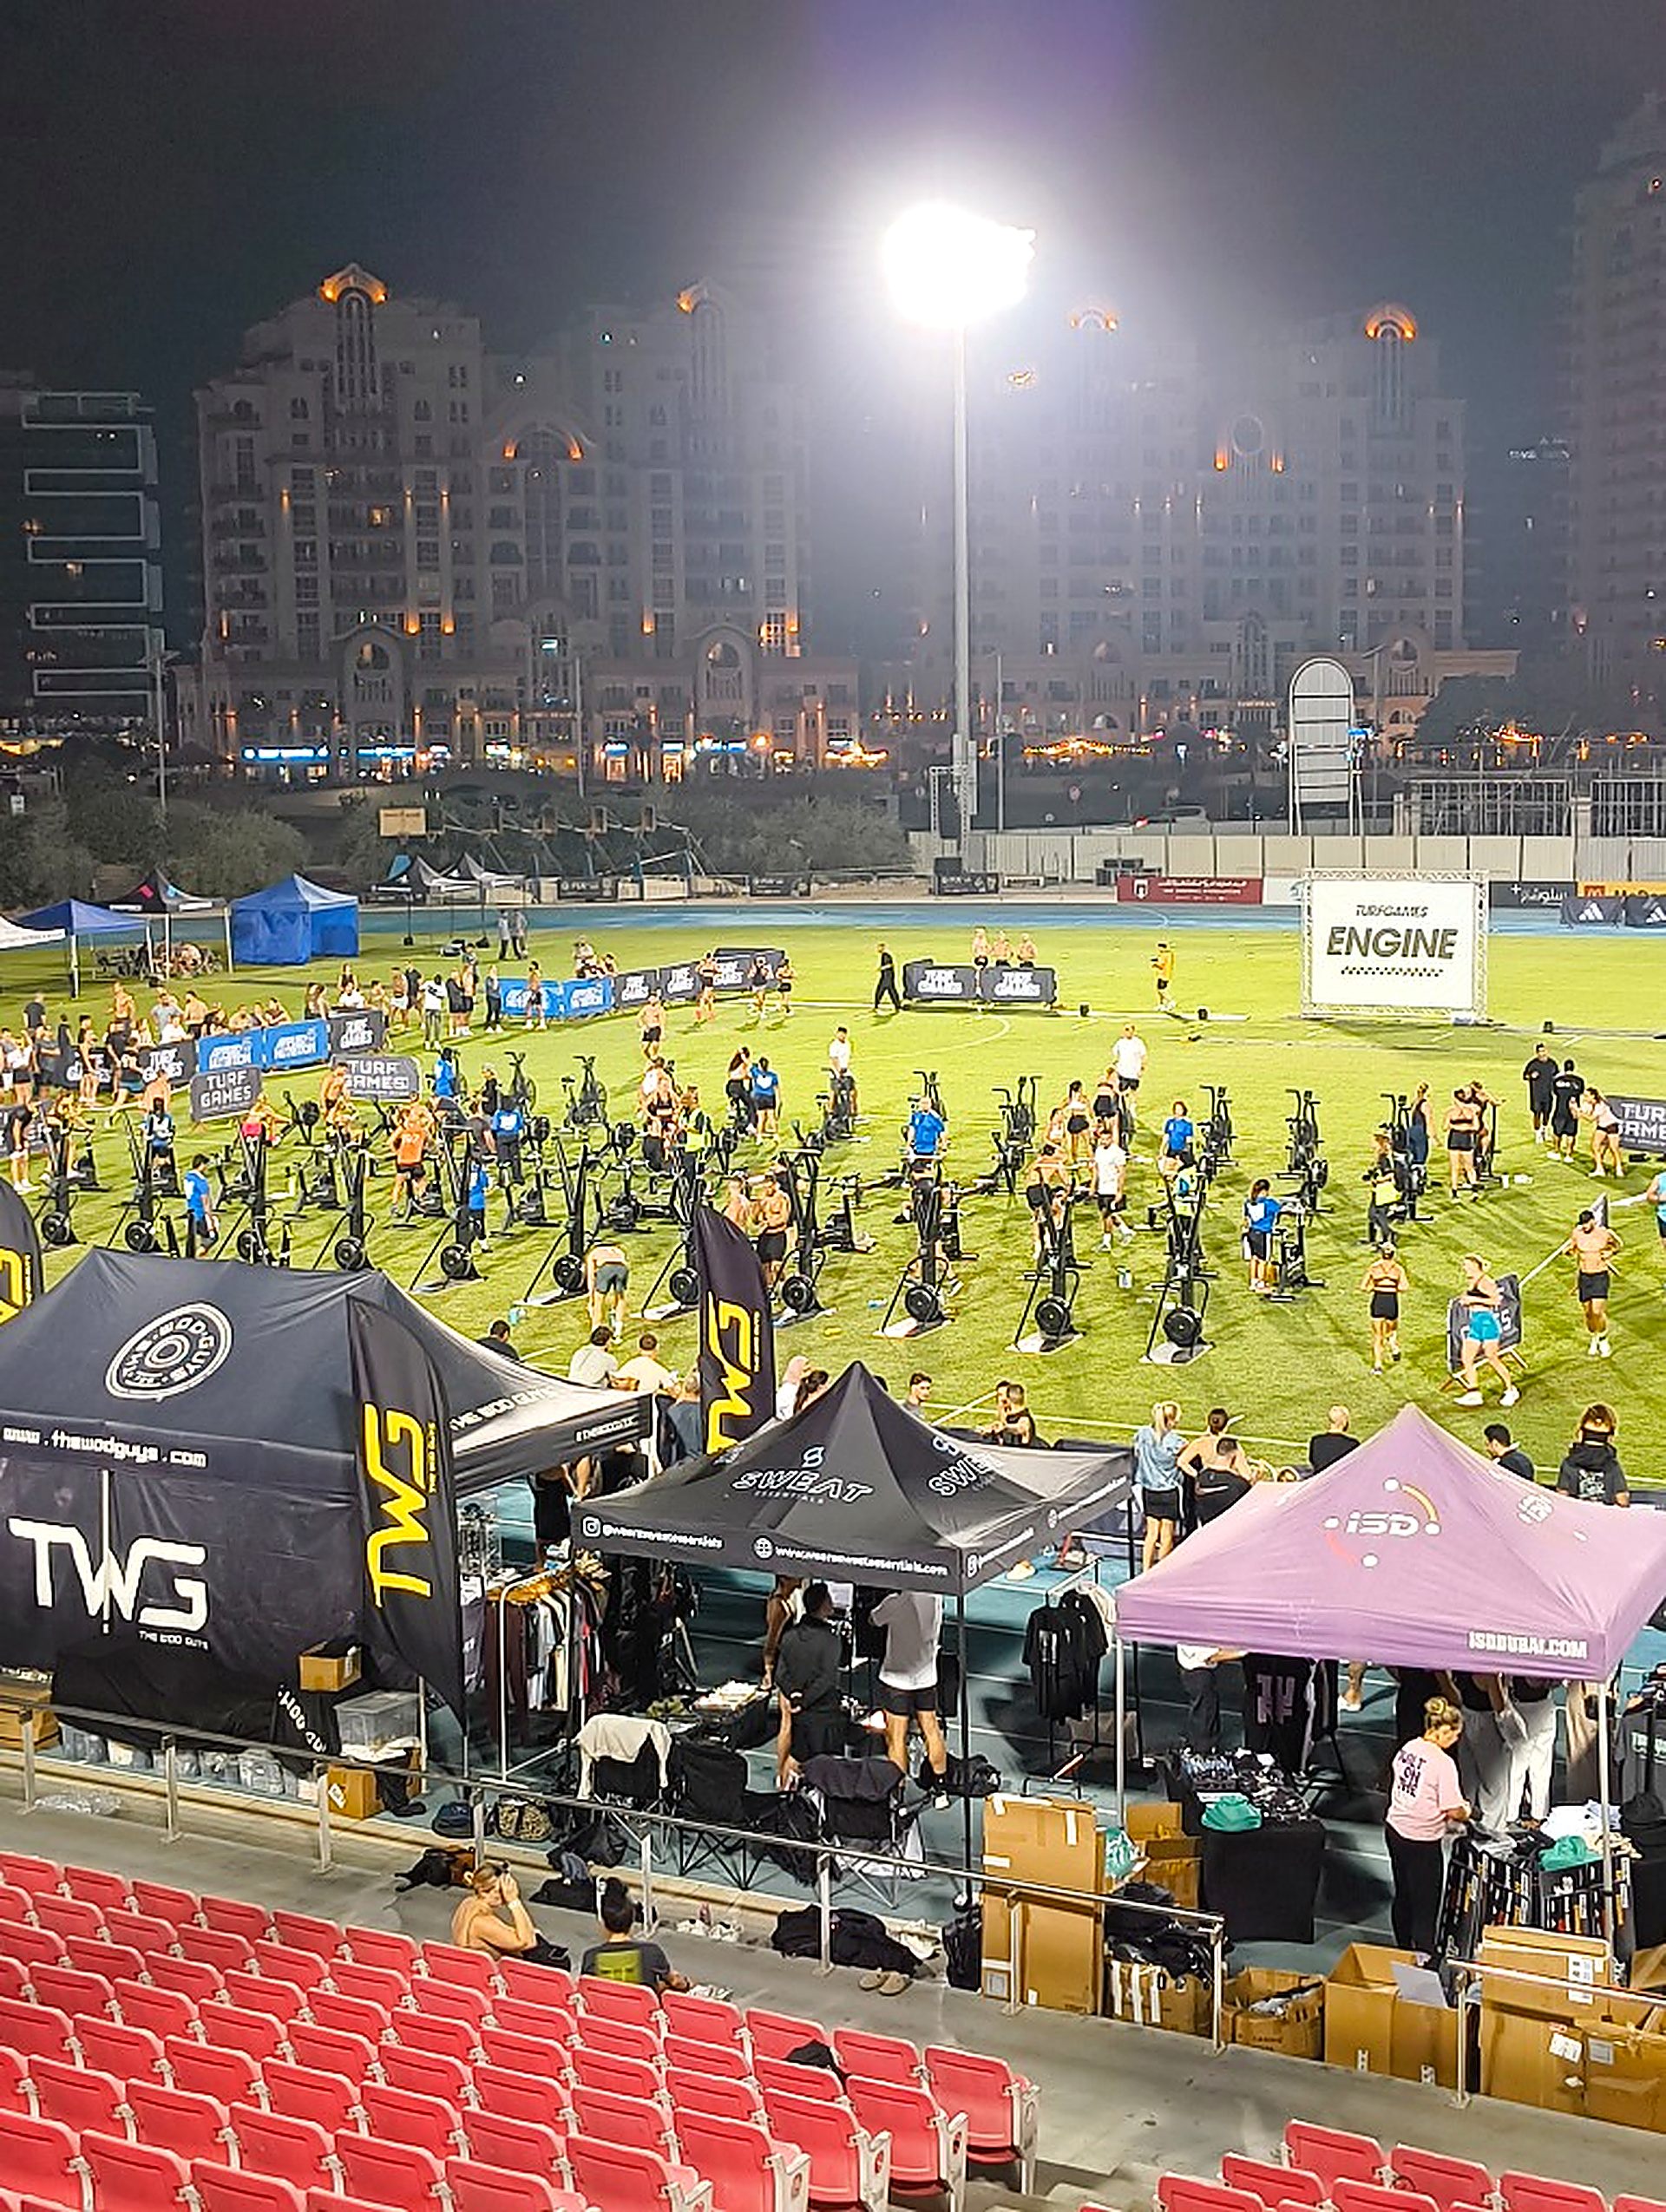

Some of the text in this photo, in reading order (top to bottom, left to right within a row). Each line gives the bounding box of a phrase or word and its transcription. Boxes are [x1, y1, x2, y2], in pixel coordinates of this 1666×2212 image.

[1326, 926, 1459, 959] ENGINE
[206, 1070, 247, 1089] TURF
[347, 1060, 400, 1075] TURF
[200, 1086, 252, 1108] GAMES
[732, 1469, 873, 1502] SWEAT
[8, 1518, 207, 1632] TWG
